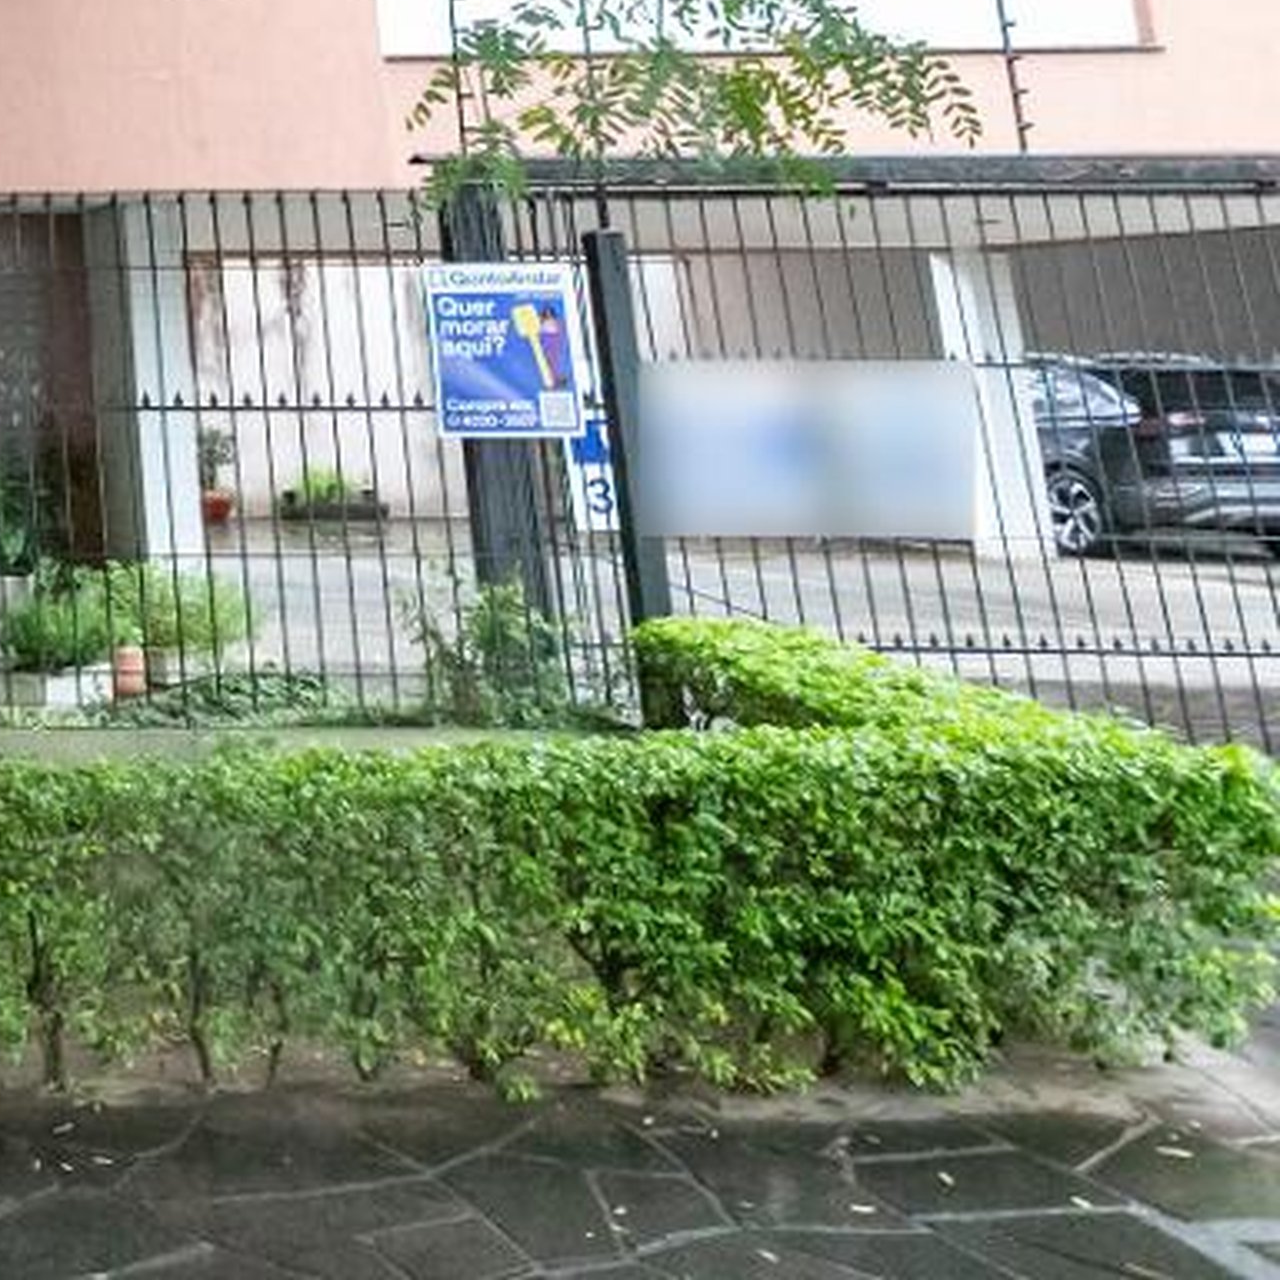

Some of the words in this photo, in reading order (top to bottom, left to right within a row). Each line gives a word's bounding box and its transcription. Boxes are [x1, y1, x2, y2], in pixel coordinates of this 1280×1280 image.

[438, 297, 496, 316] Quer
[441, 319, 509, 335] morar
[443, 336, 505, 357] aqui?
